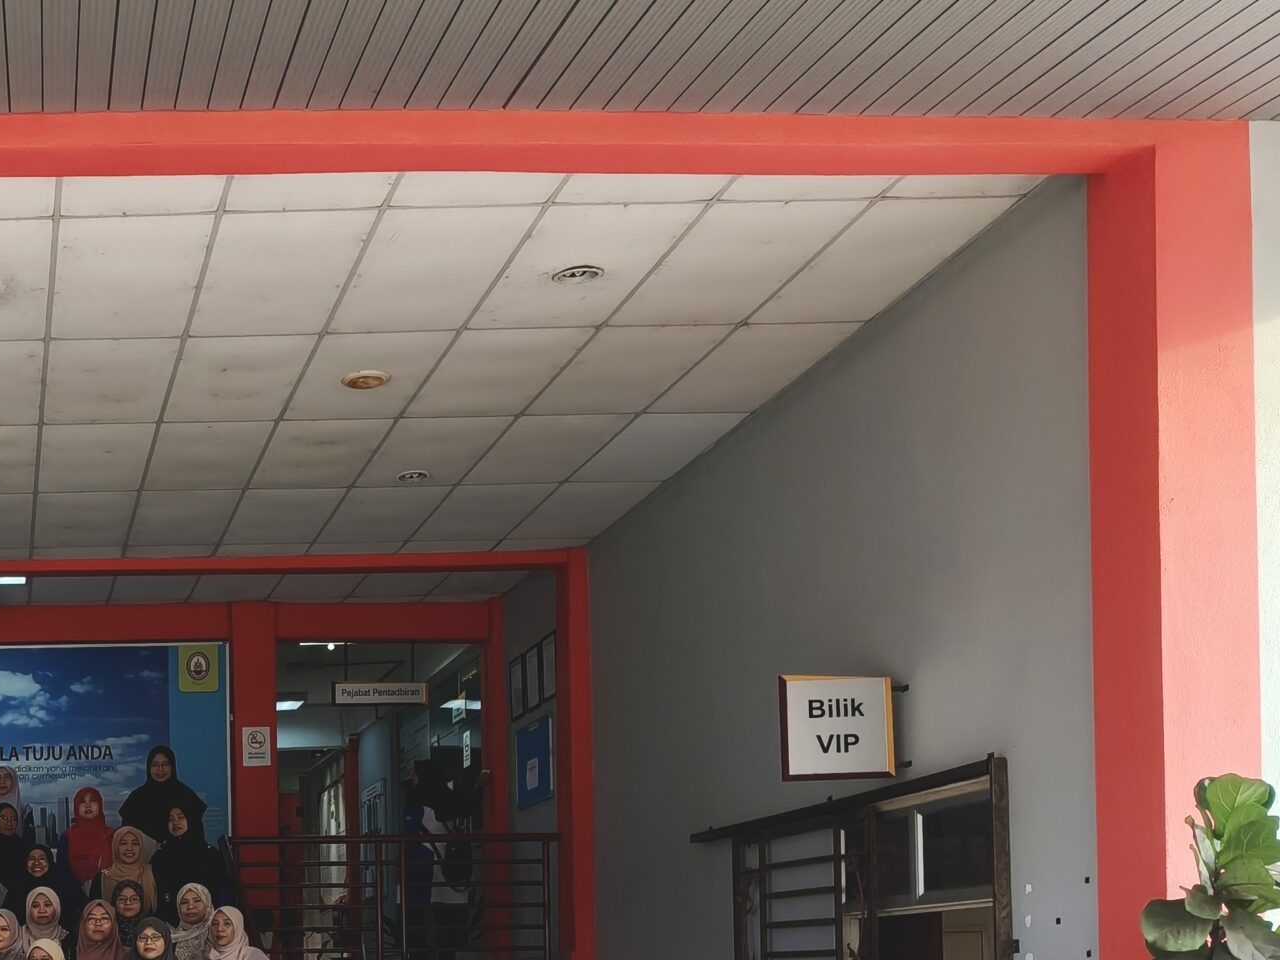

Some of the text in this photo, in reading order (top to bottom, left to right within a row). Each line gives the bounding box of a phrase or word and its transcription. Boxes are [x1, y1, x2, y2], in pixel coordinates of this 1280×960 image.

[341, 687, 420, 699] Pejabat Pentadbiran
[808, 698, 865, 718] Bilik
[816, 733, 860, 754] VIP
[23, 746, 63, 761] TUJU
[66, 745, 114, 760] ANDA
[45, 766, 66, 775] yang
